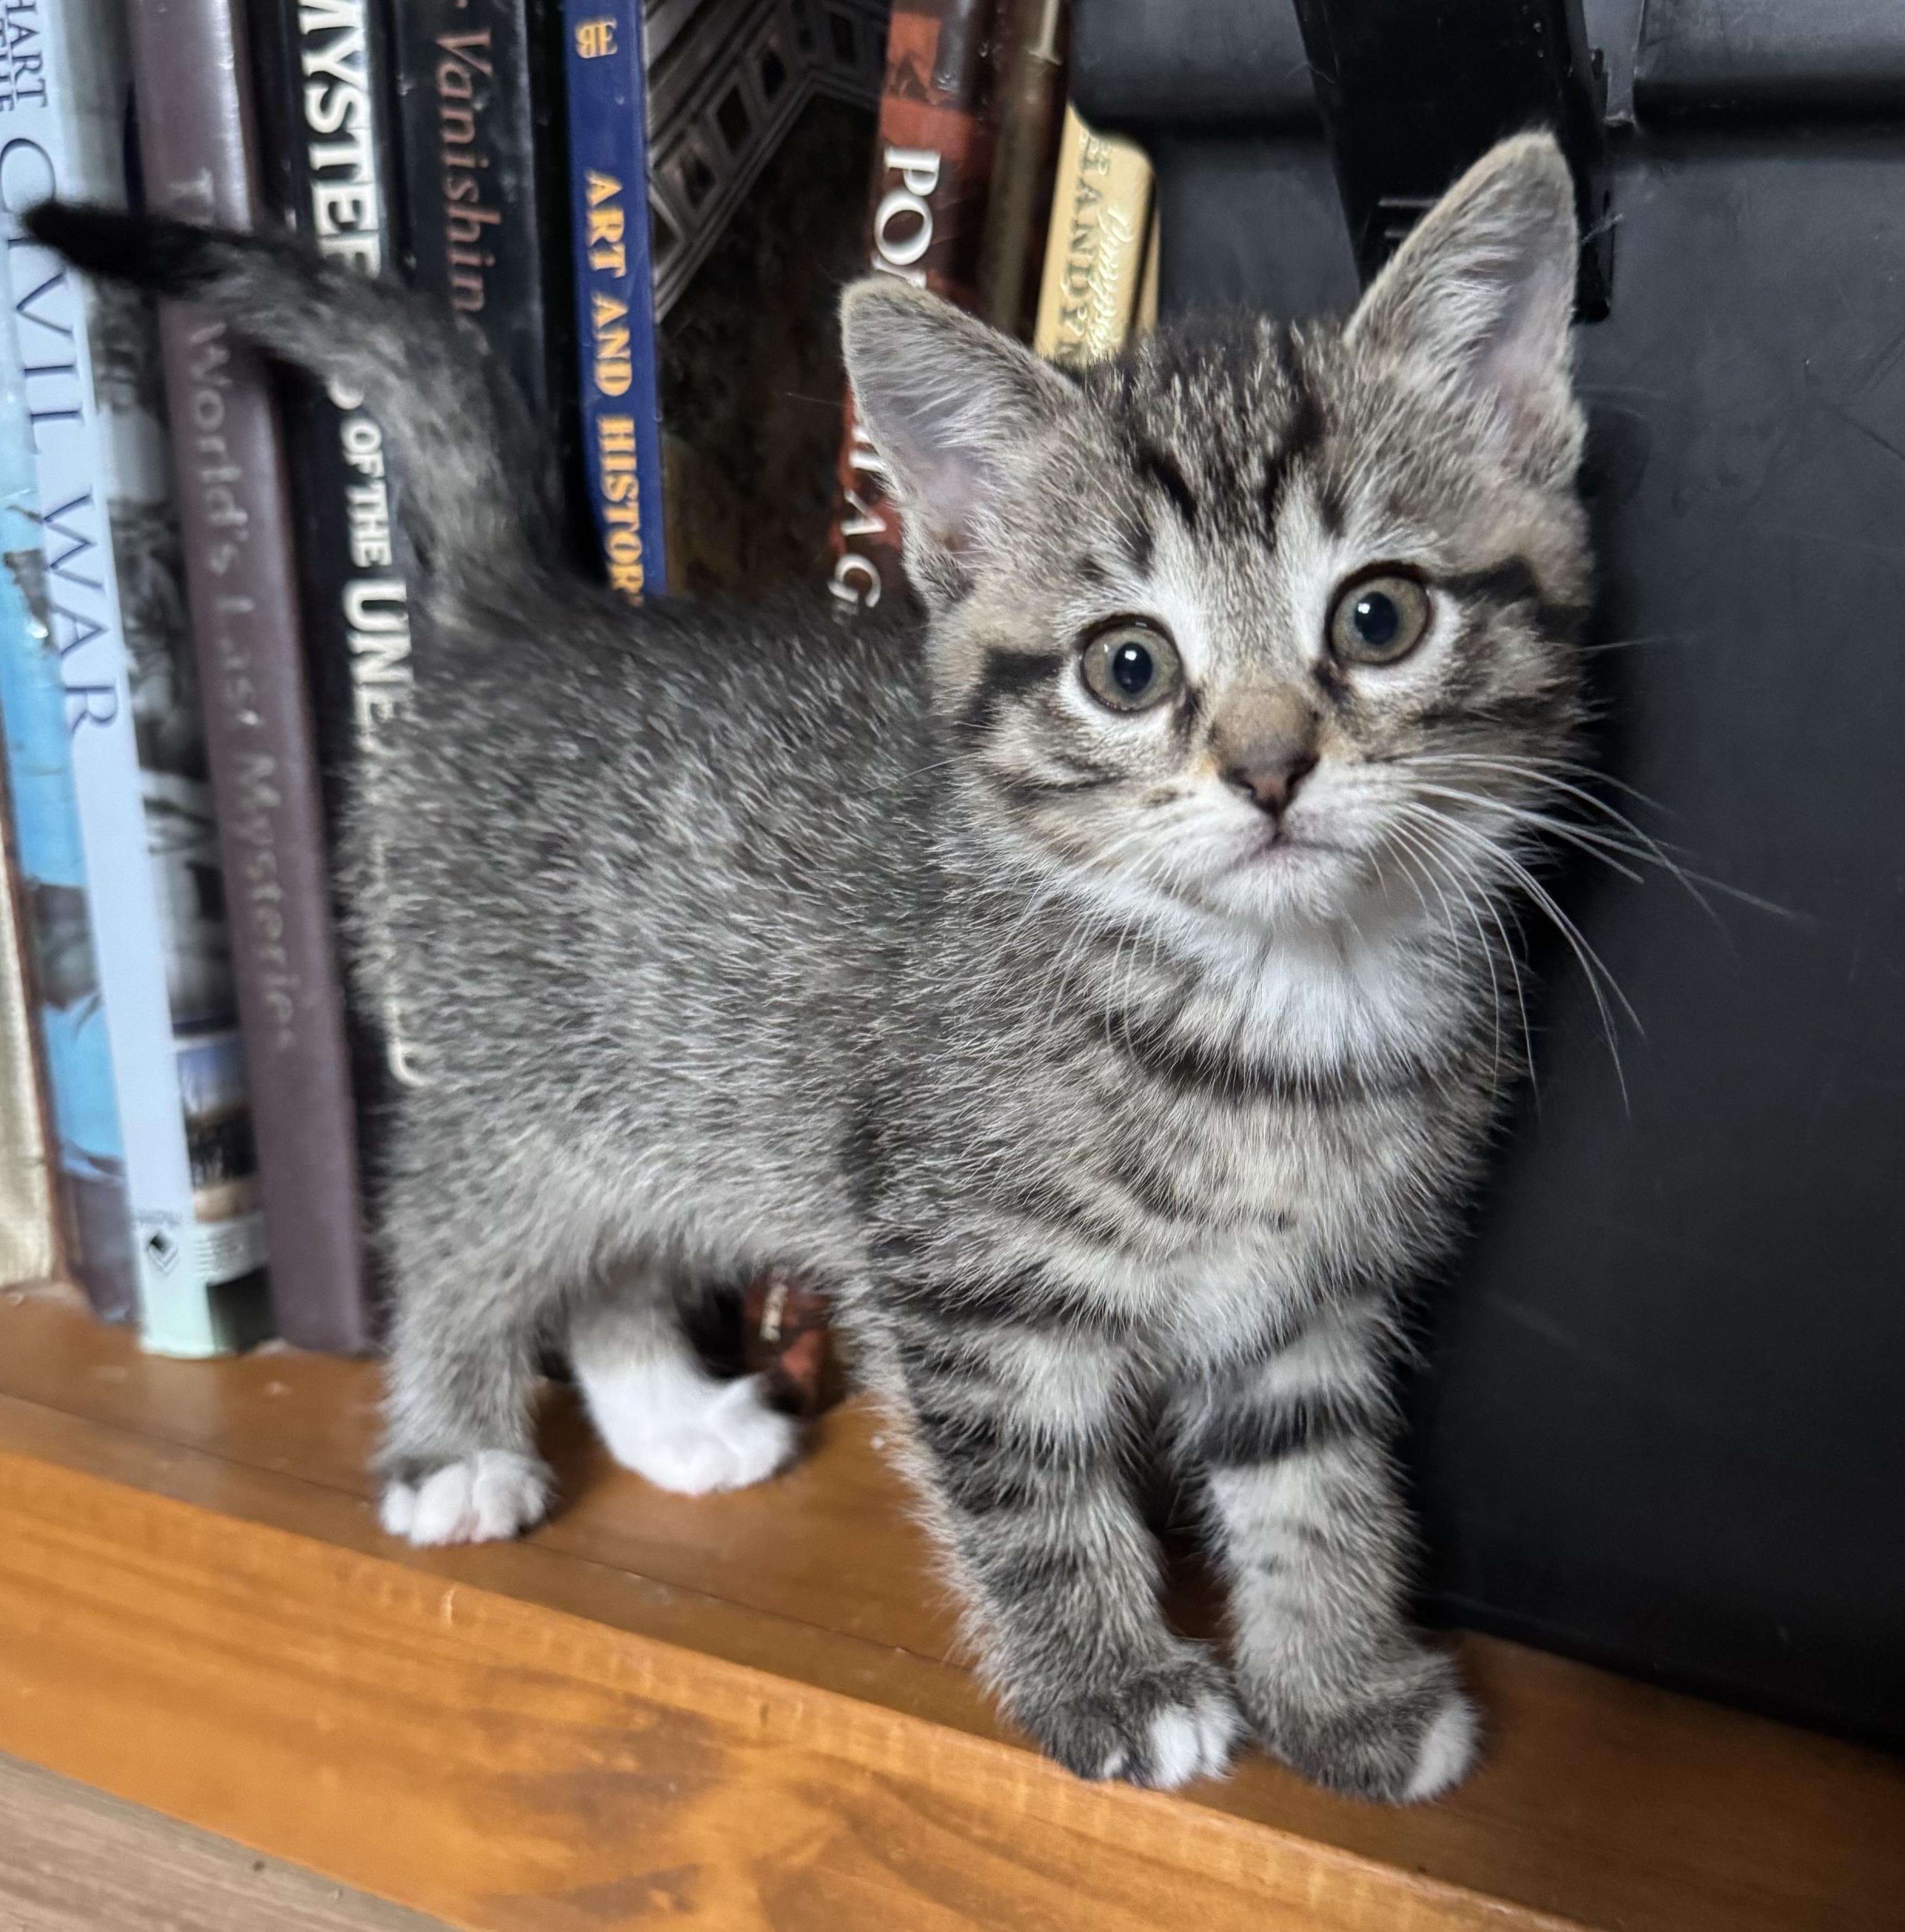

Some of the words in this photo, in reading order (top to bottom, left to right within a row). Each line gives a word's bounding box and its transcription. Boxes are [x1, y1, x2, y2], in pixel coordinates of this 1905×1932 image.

[435, 29, 501, 312] Vanishin
[585, 169, 627, 278] ART
[591, 290, 633, 397] AND
[340, 416, 385, 478] OF
[345, 480, 392, 568] THE
[597, 415, 645, 607] HISTOR
[42, 485, 118, 735] WAR
